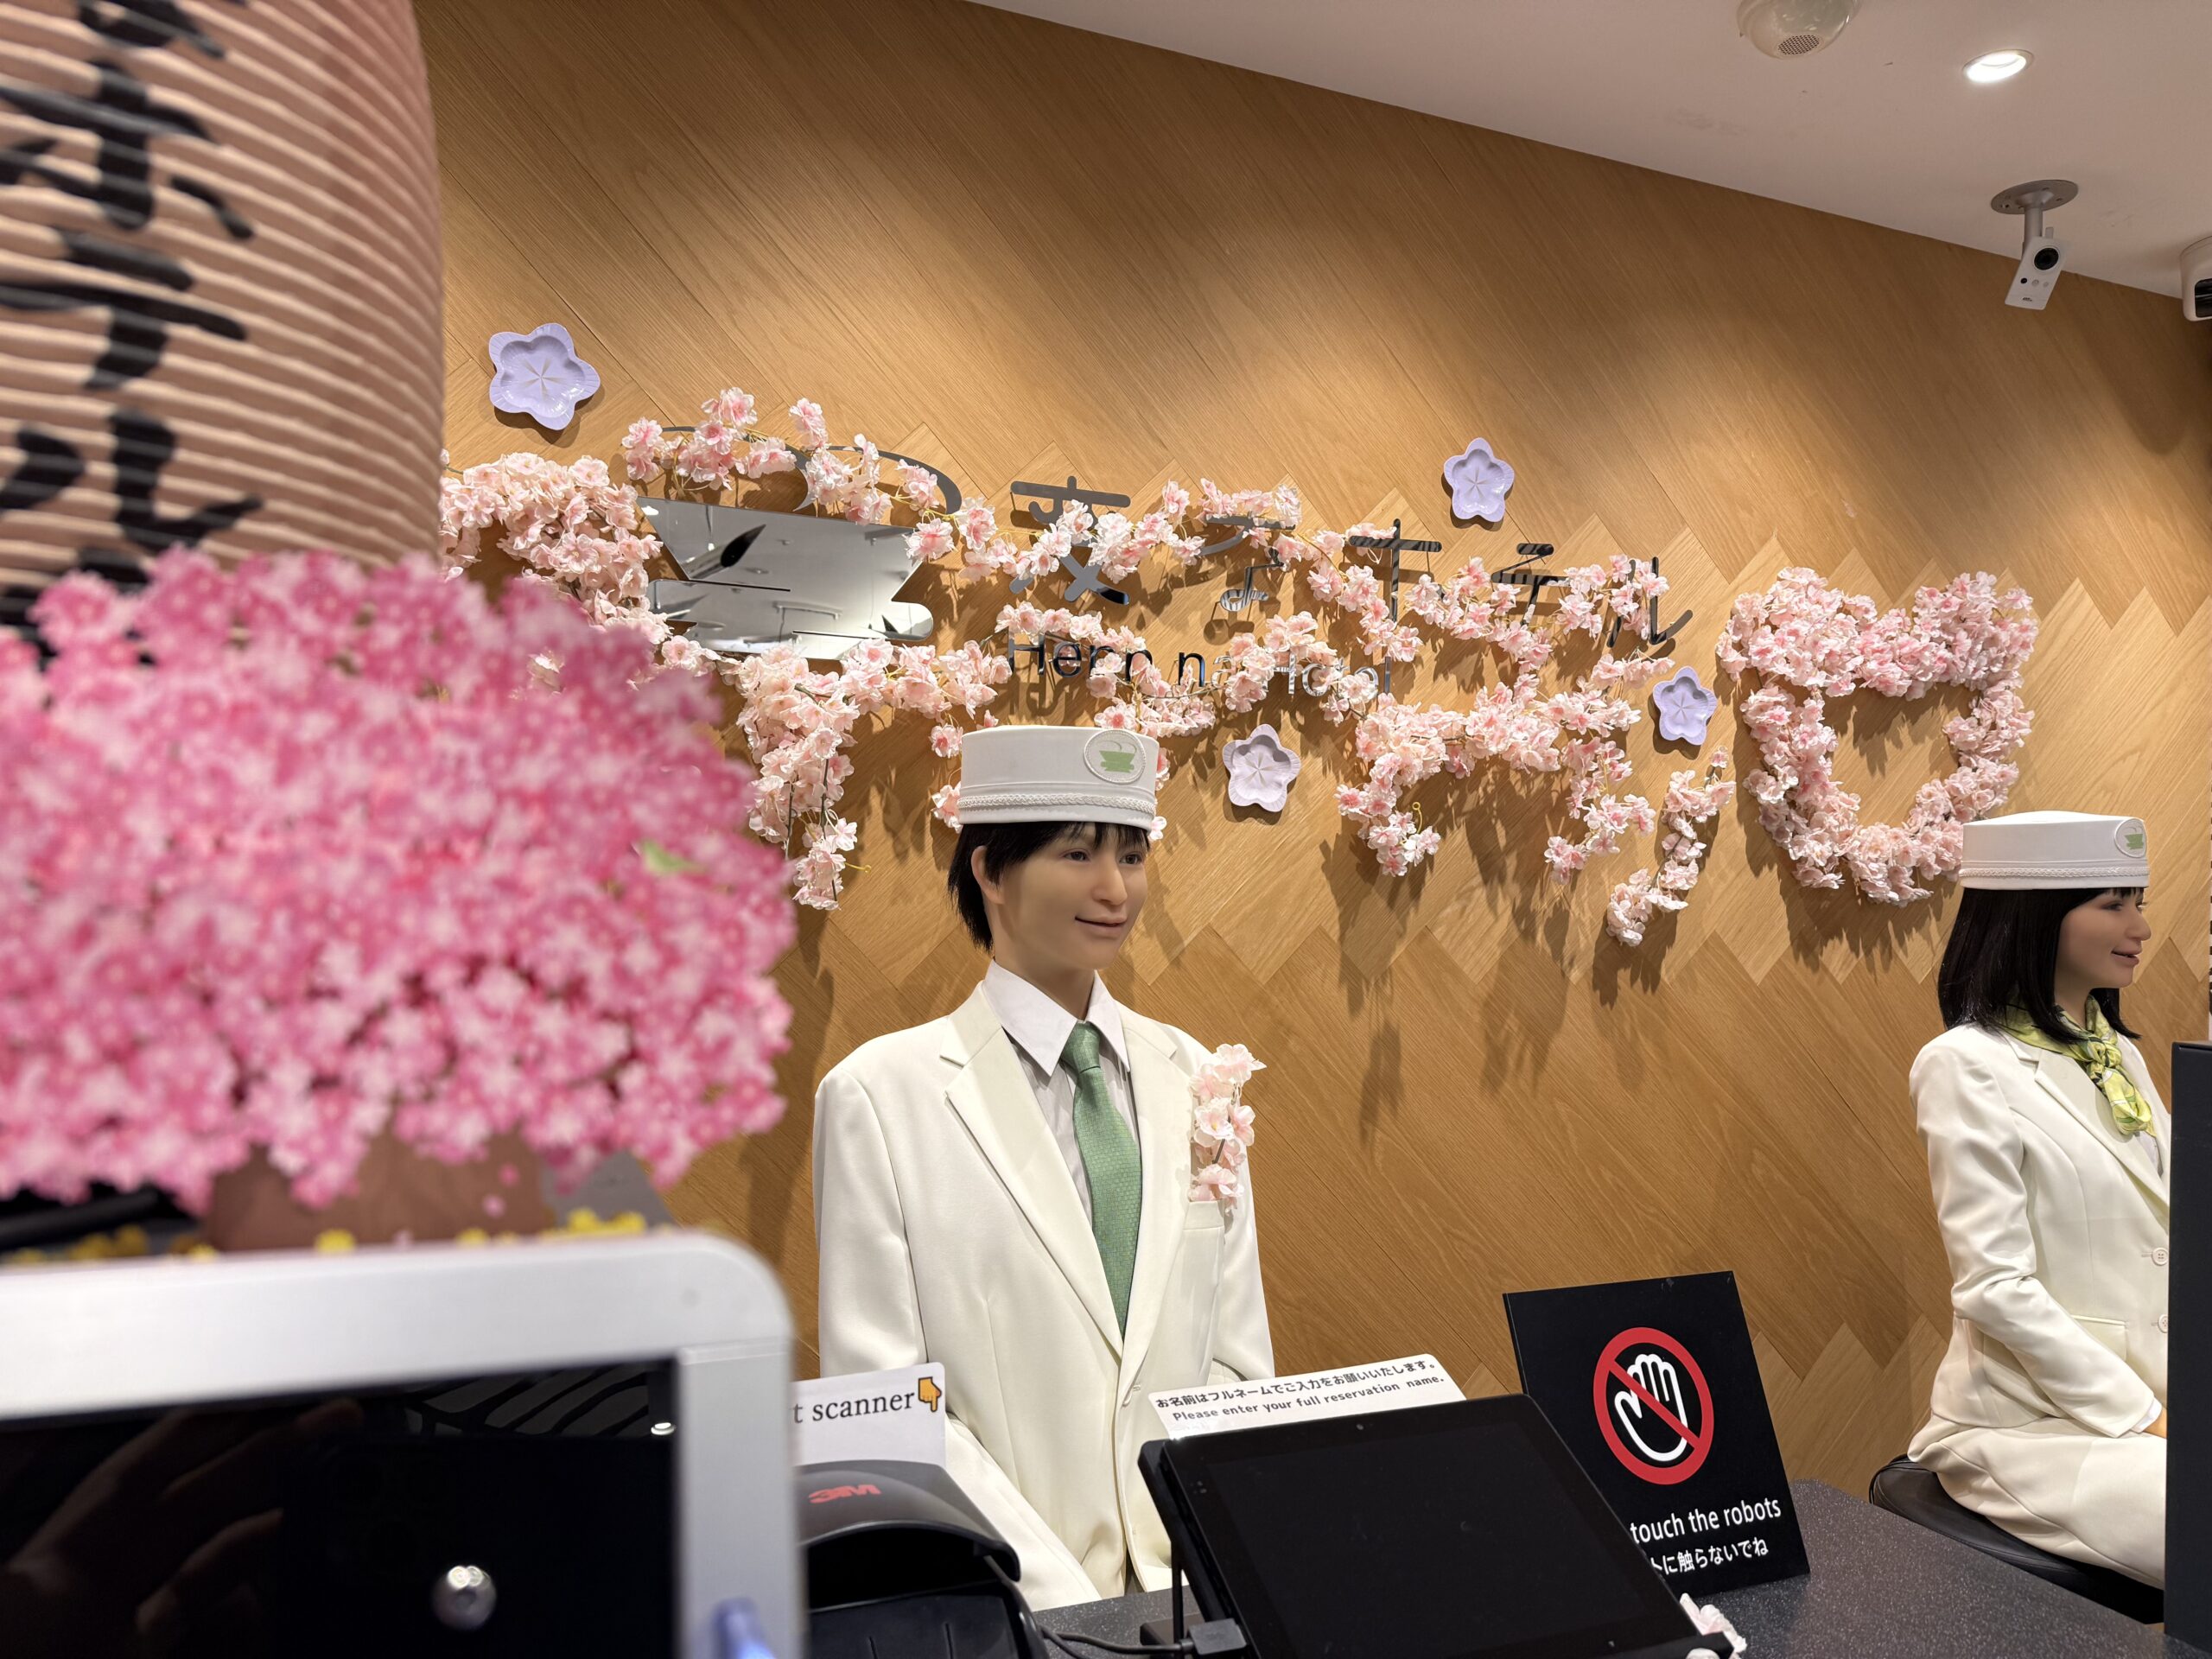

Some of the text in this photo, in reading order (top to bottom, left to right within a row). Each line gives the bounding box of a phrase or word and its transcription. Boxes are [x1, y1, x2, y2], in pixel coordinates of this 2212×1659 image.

[1156, 1360, 1435, 1408] お名前はフルネームでご入力をお願いいたします。
[1173, 1376, 1445, 1421] Please enter your full reservation name.
[812, 1392, 915, 1422] scanner
[809, 1484, 881, 1503] 3M
[1630, 1497, 1782, 1545] touch the robots
